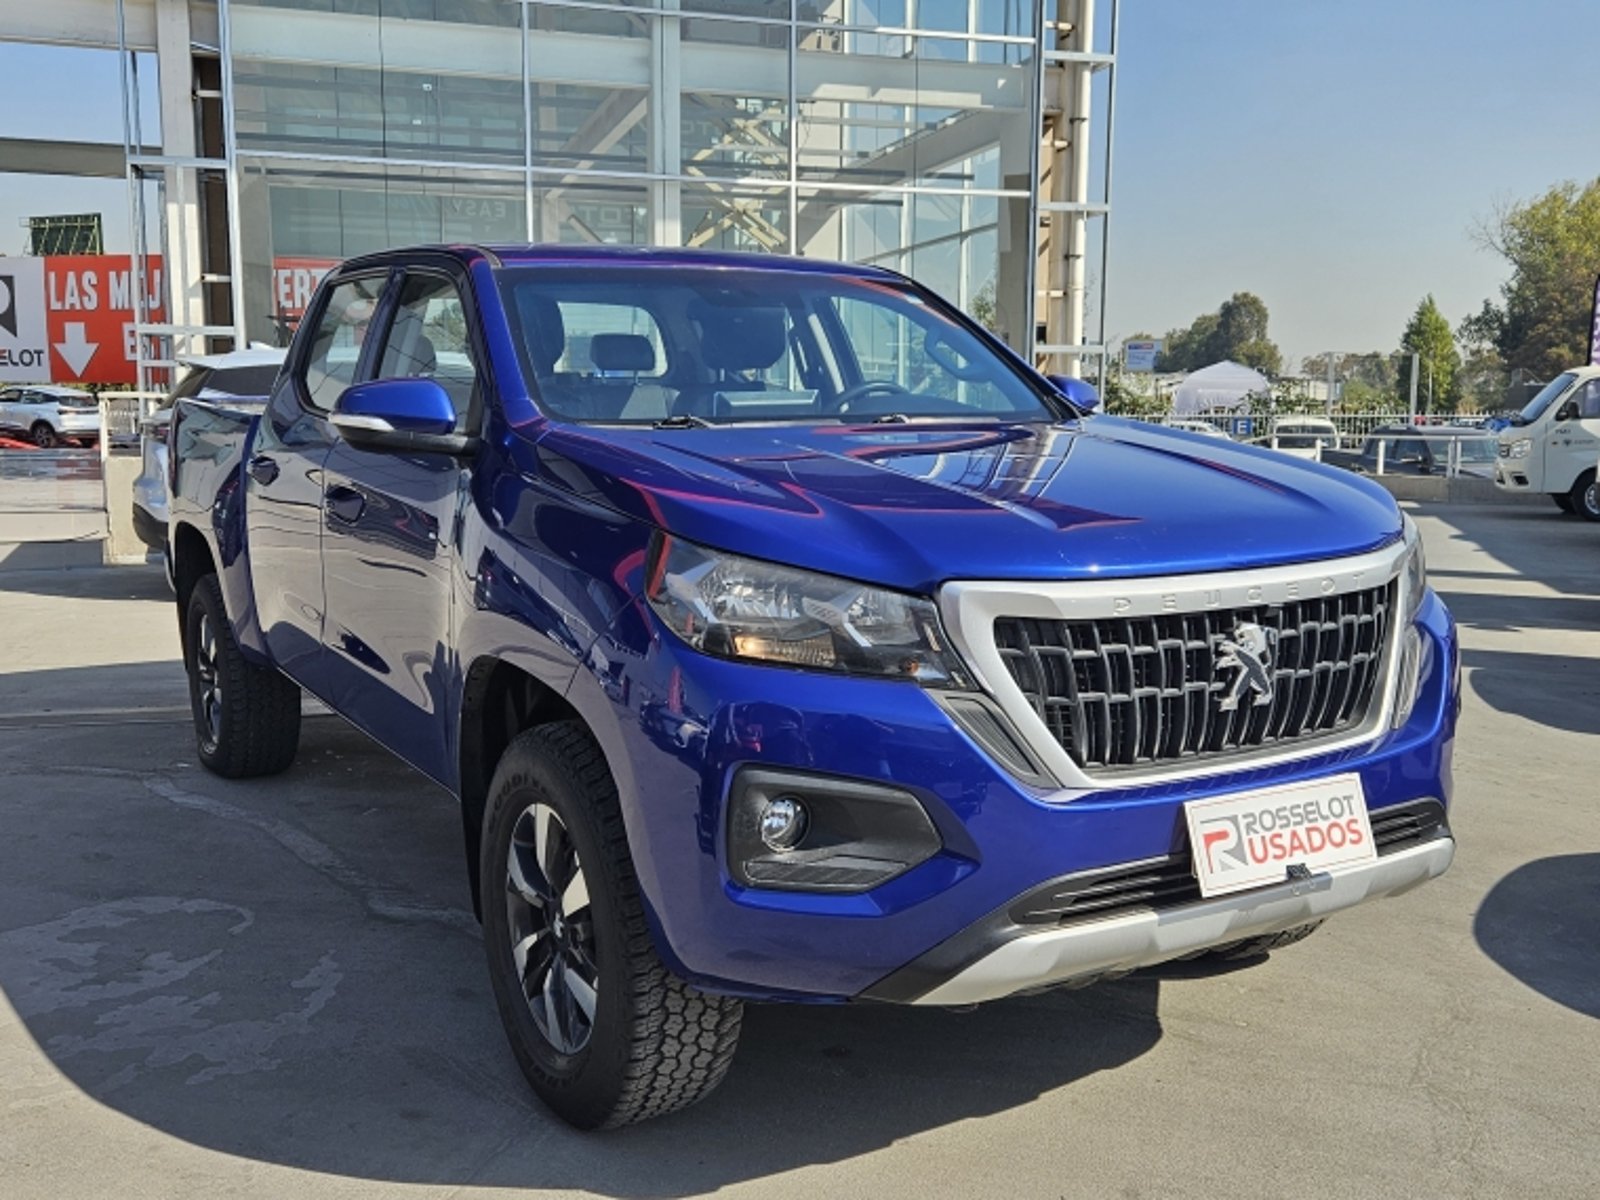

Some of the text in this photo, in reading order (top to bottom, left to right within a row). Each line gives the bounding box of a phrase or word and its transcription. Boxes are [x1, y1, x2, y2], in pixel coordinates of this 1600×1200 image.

[48, 270, 98, 310] LAS
[1237, 420, 1248, 434] E
[1112, 573, 1364, 615] PEUGEOT
[1242, 795, 1355, 834] ROSSELOT
[1248, 818, 1363, 864] USADOS
